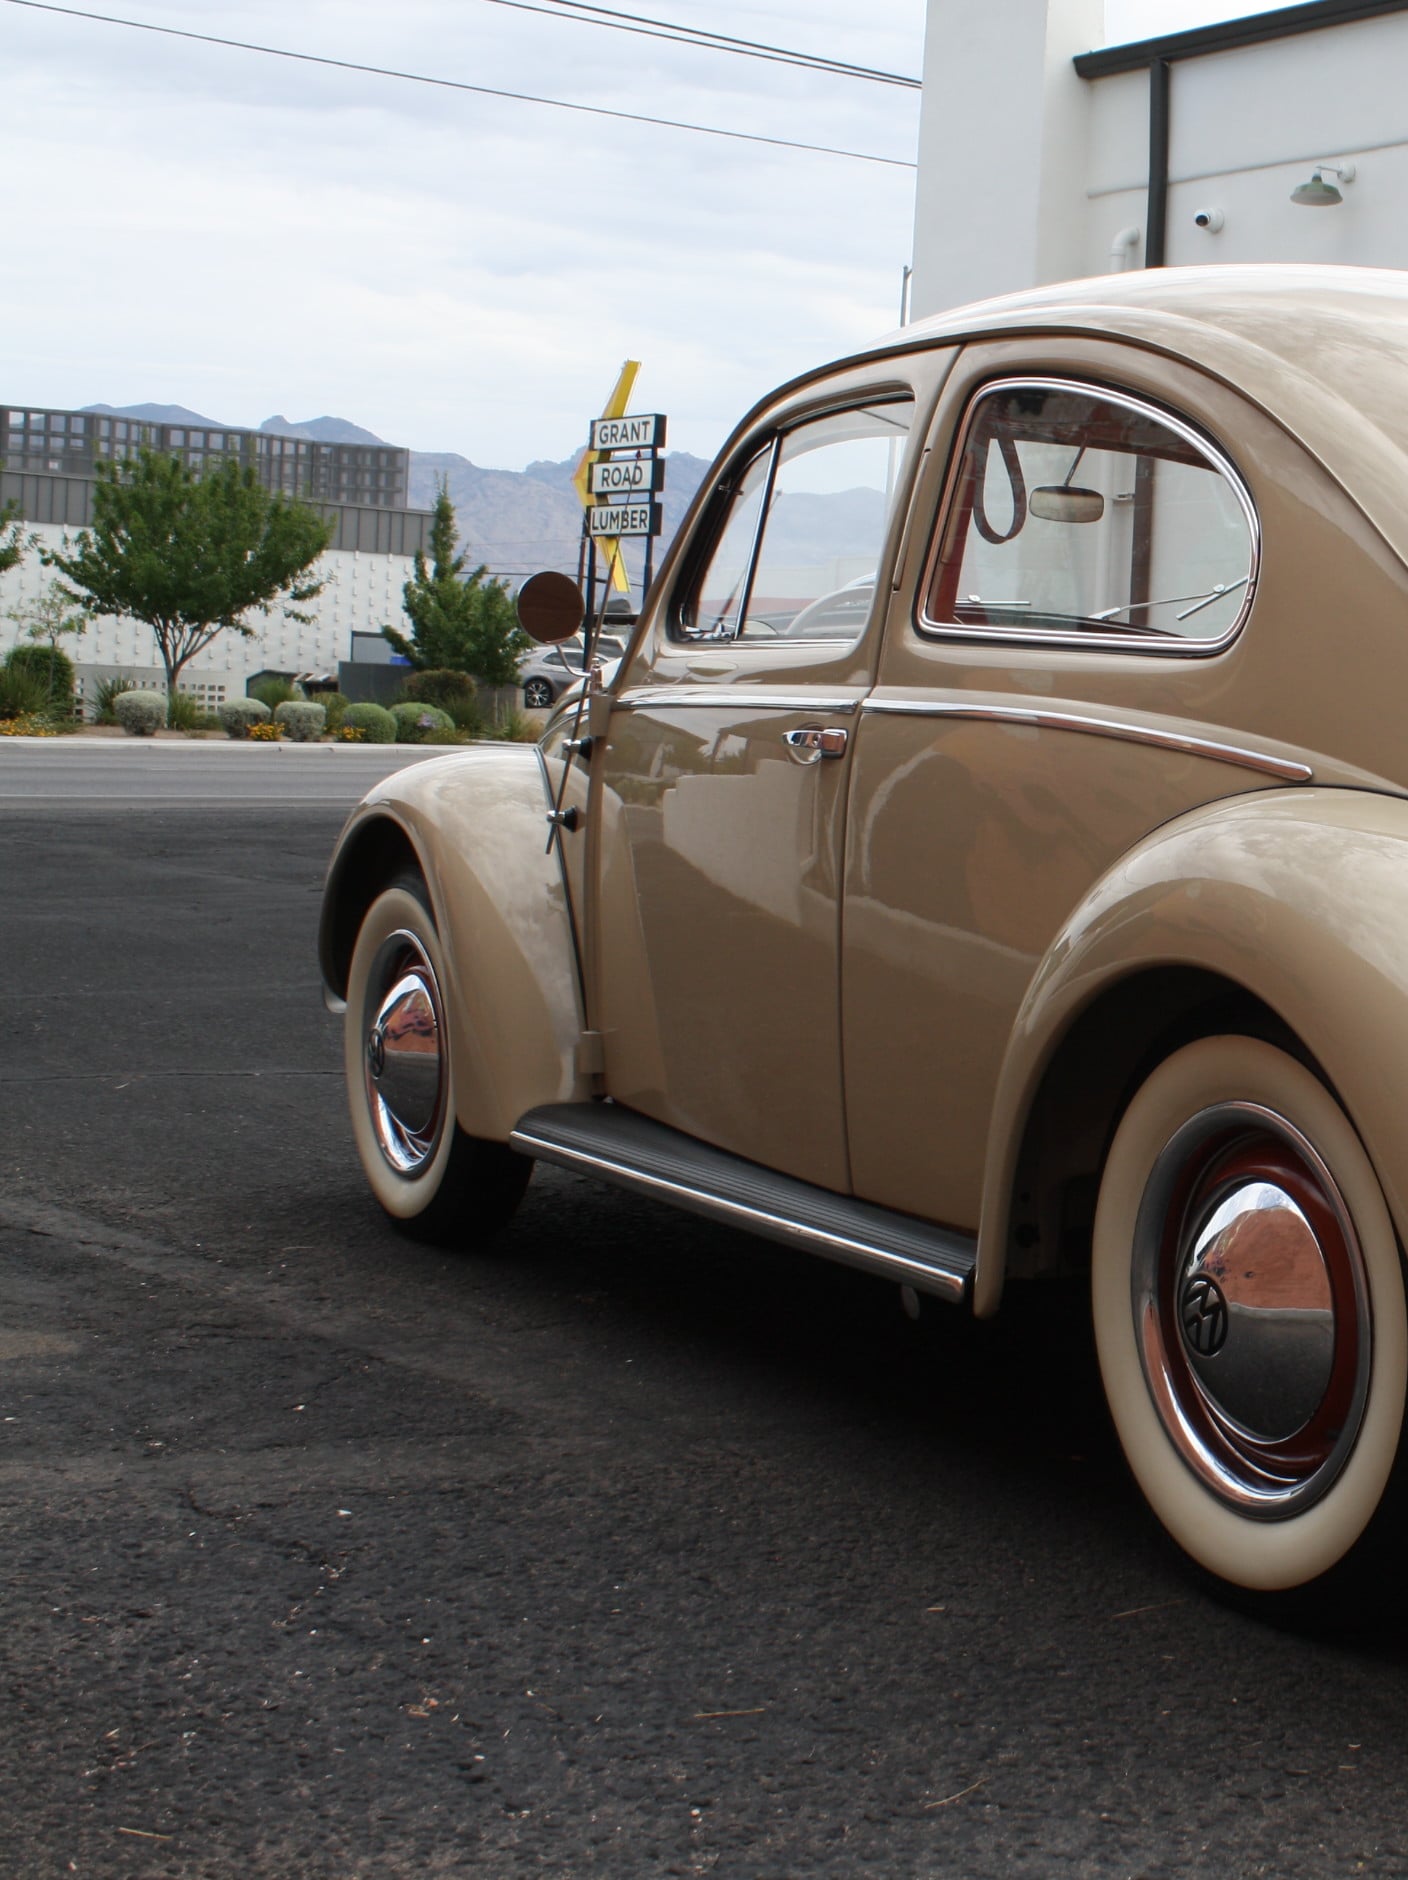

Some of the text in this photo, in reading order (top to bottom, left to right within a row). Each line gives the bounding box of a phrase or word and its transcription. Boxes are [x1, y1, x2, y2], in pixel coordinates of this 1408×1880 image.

[600, 421, 650, 444] GRANT
[601, 465, 643, 487] ROAD
[591, 509, 648, 531] LUMBER
